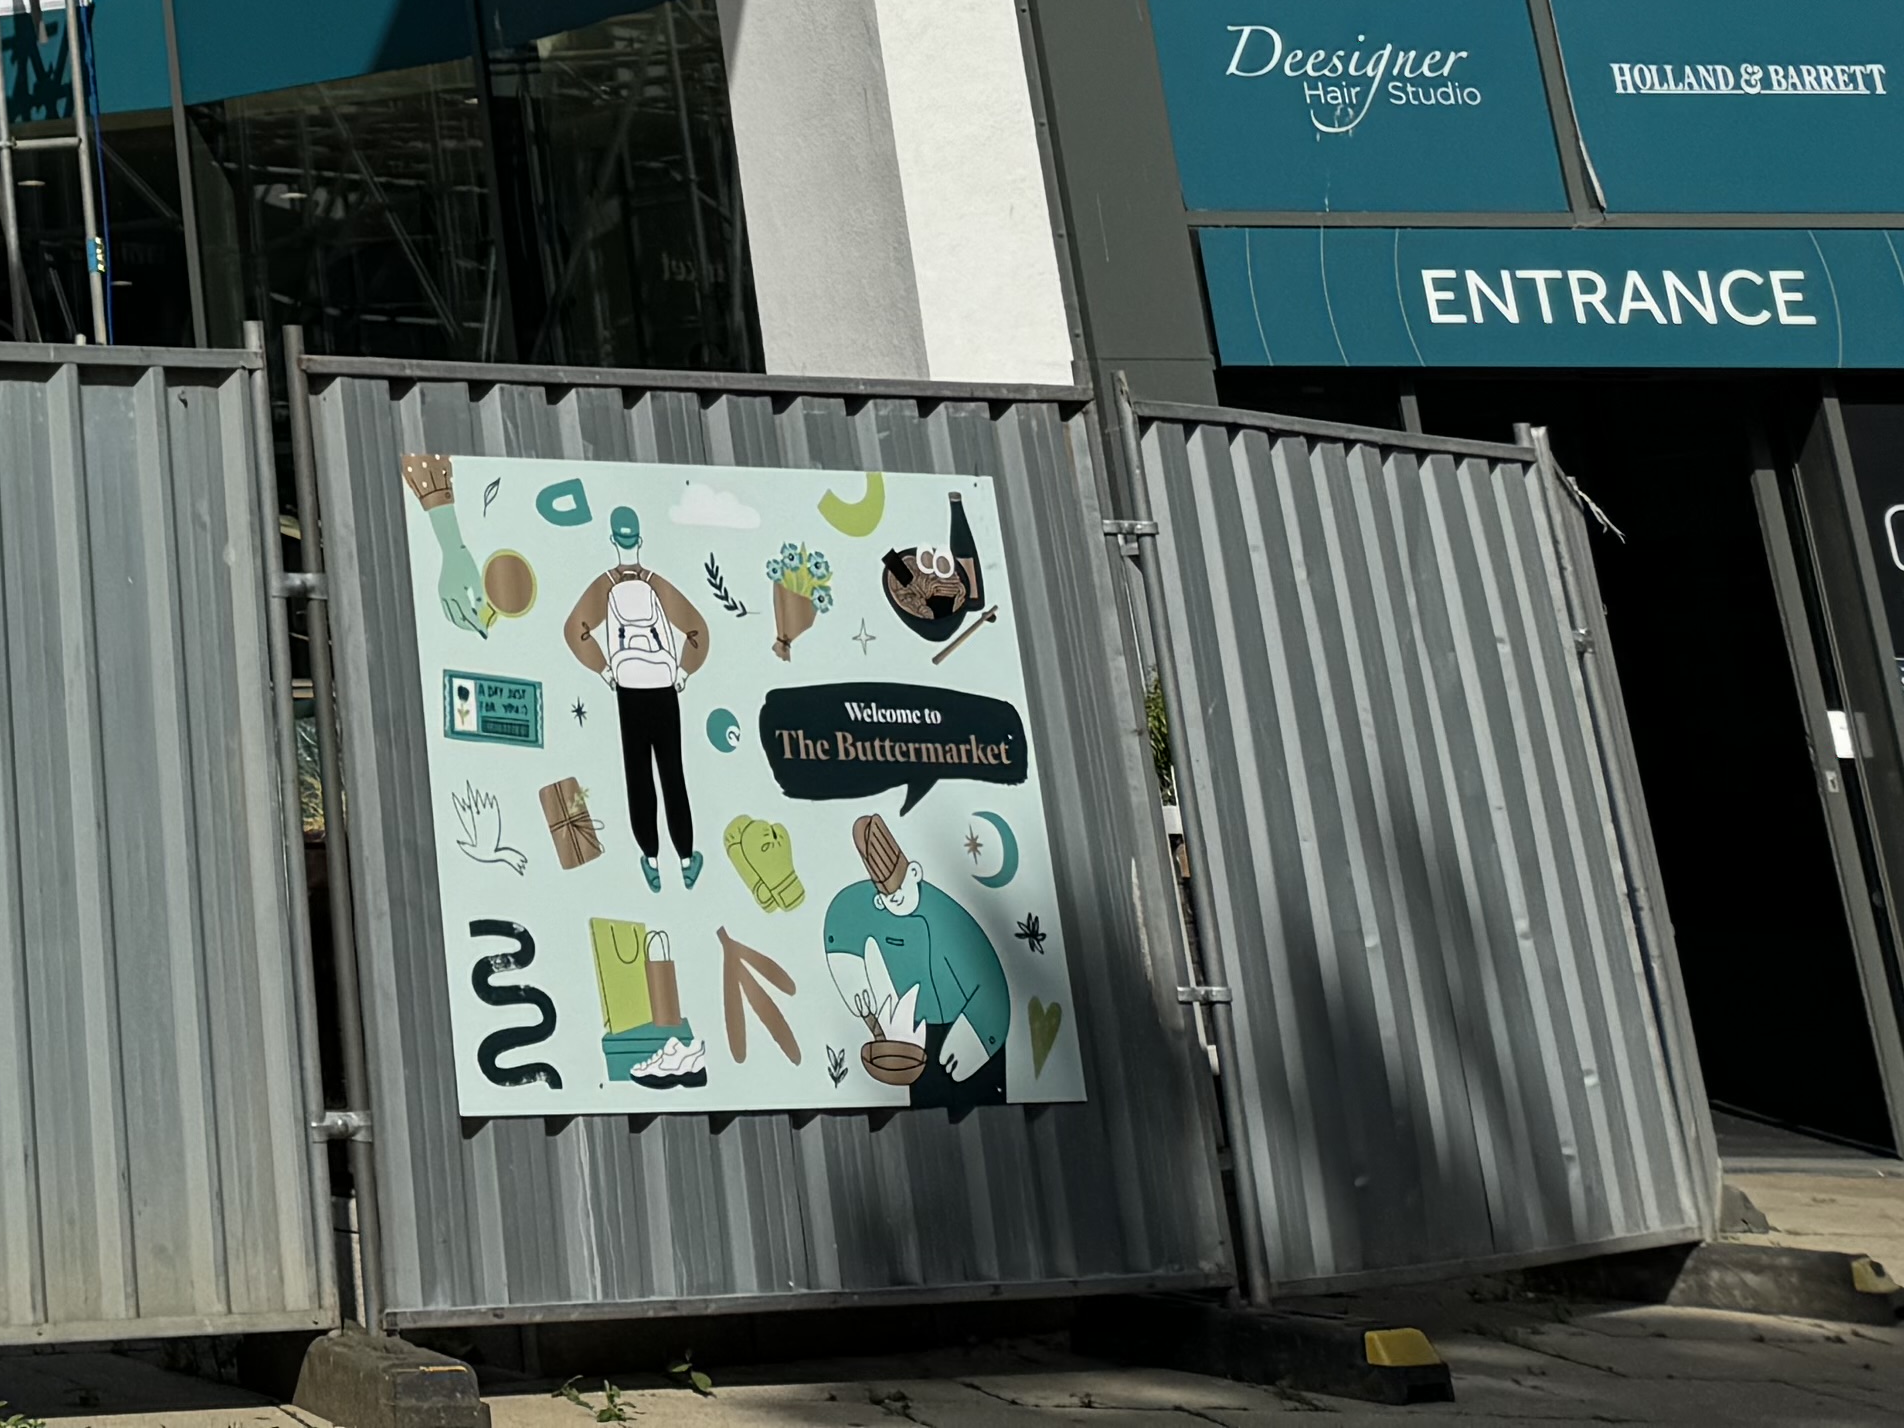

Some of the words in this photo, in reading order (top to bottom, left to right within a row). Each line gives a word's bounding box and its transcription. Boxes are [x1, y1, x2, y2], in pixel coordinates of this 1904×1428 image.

[1225, 24, 1469, 133] Deesigner
[1303, 81, 1359, 106] Hair
[1388, 80, 1482, 107] Studio
[1609, 63, 1735, 93] HOLLAND
[1740, 63, 1763, 94] &
[1768, 64, 1887, 94] BARRETT
[1420, 268, 1817, 326] ENTRANCE
[844, 701, 921, 725] Welcome
[925, 708, 942, 725] to
[775, 729, 830, 761] The
[834, 731, 1012, 765] Buttermarket
